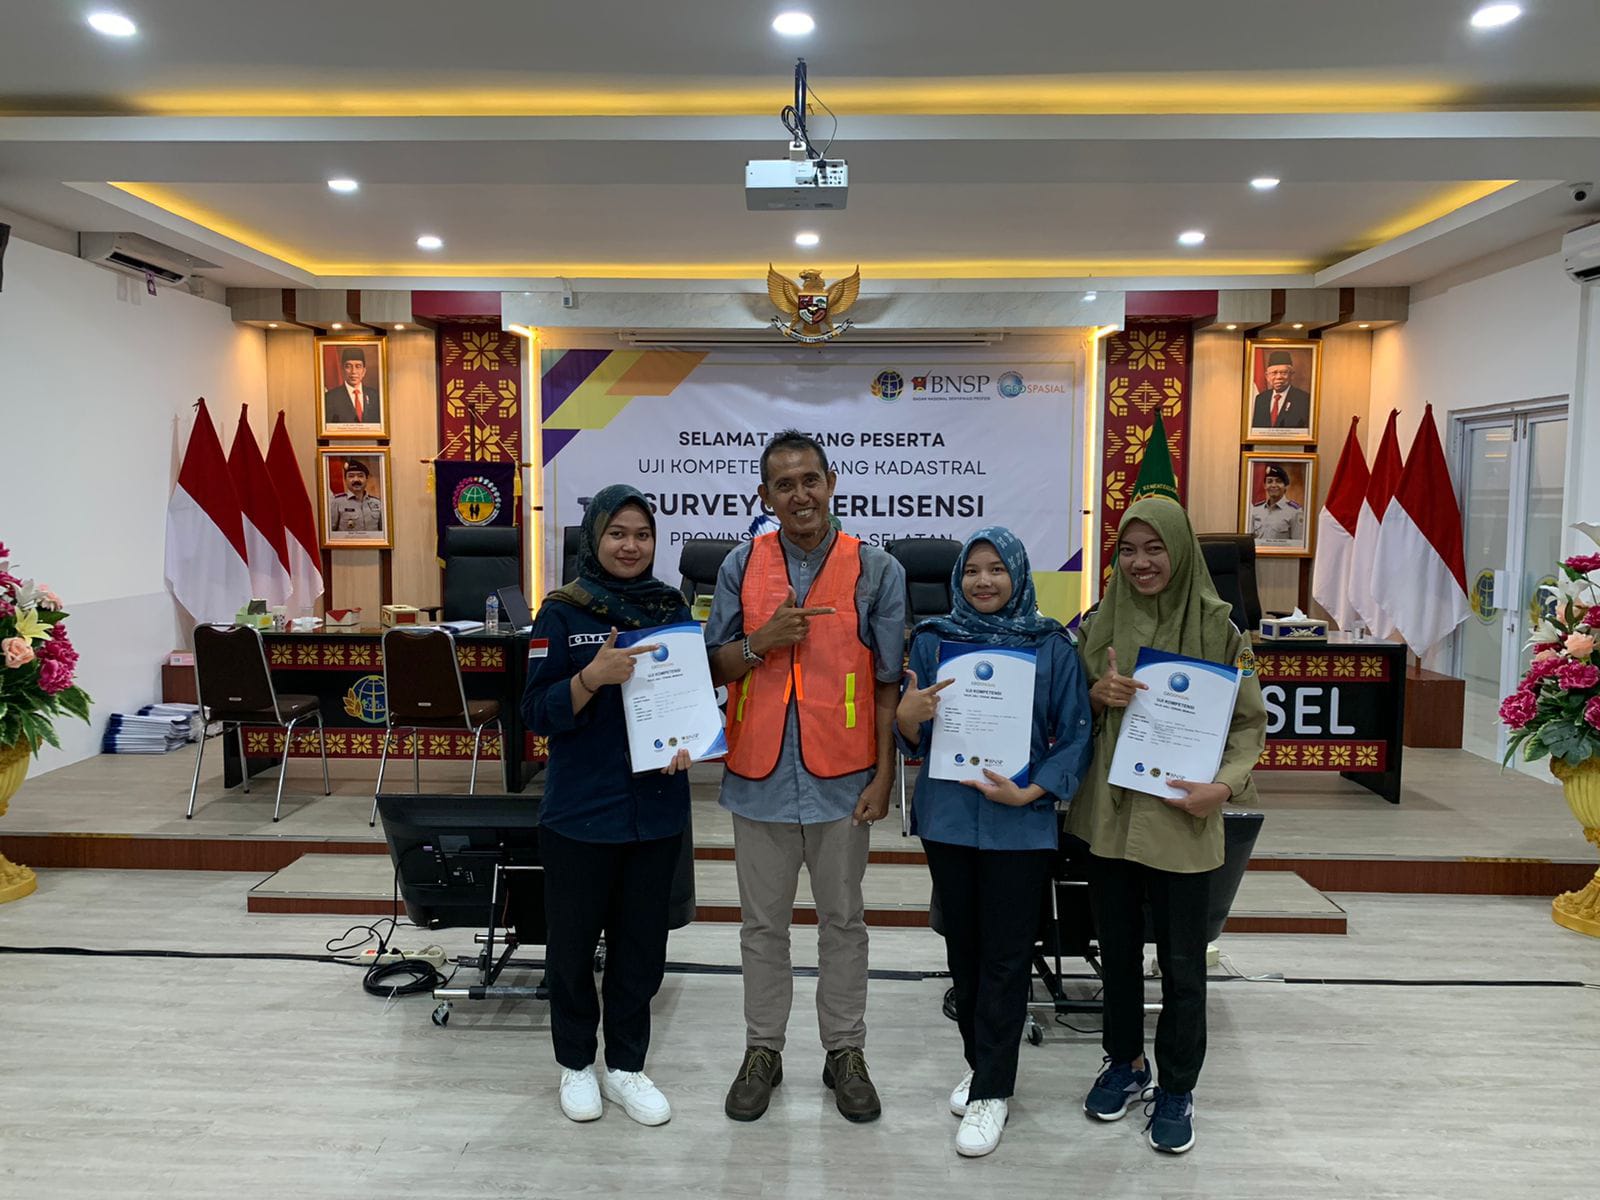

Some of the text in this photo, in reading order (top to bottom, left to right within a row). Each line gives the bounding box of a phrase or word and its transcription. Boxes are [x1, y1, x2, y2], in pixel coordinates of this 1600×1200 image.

[931, 375, 990, 393] BNSP
[679, 431, 769, 447] SELAMAT
[860, 433, 946, 447] PESERTA
[638, 459, 987, 476] UJI KOMPETE ANG KADASTRAL
[644, 493, 984, 518] SURVEY ERLISENSI
[670, 531, 753, 546] PROVINS
